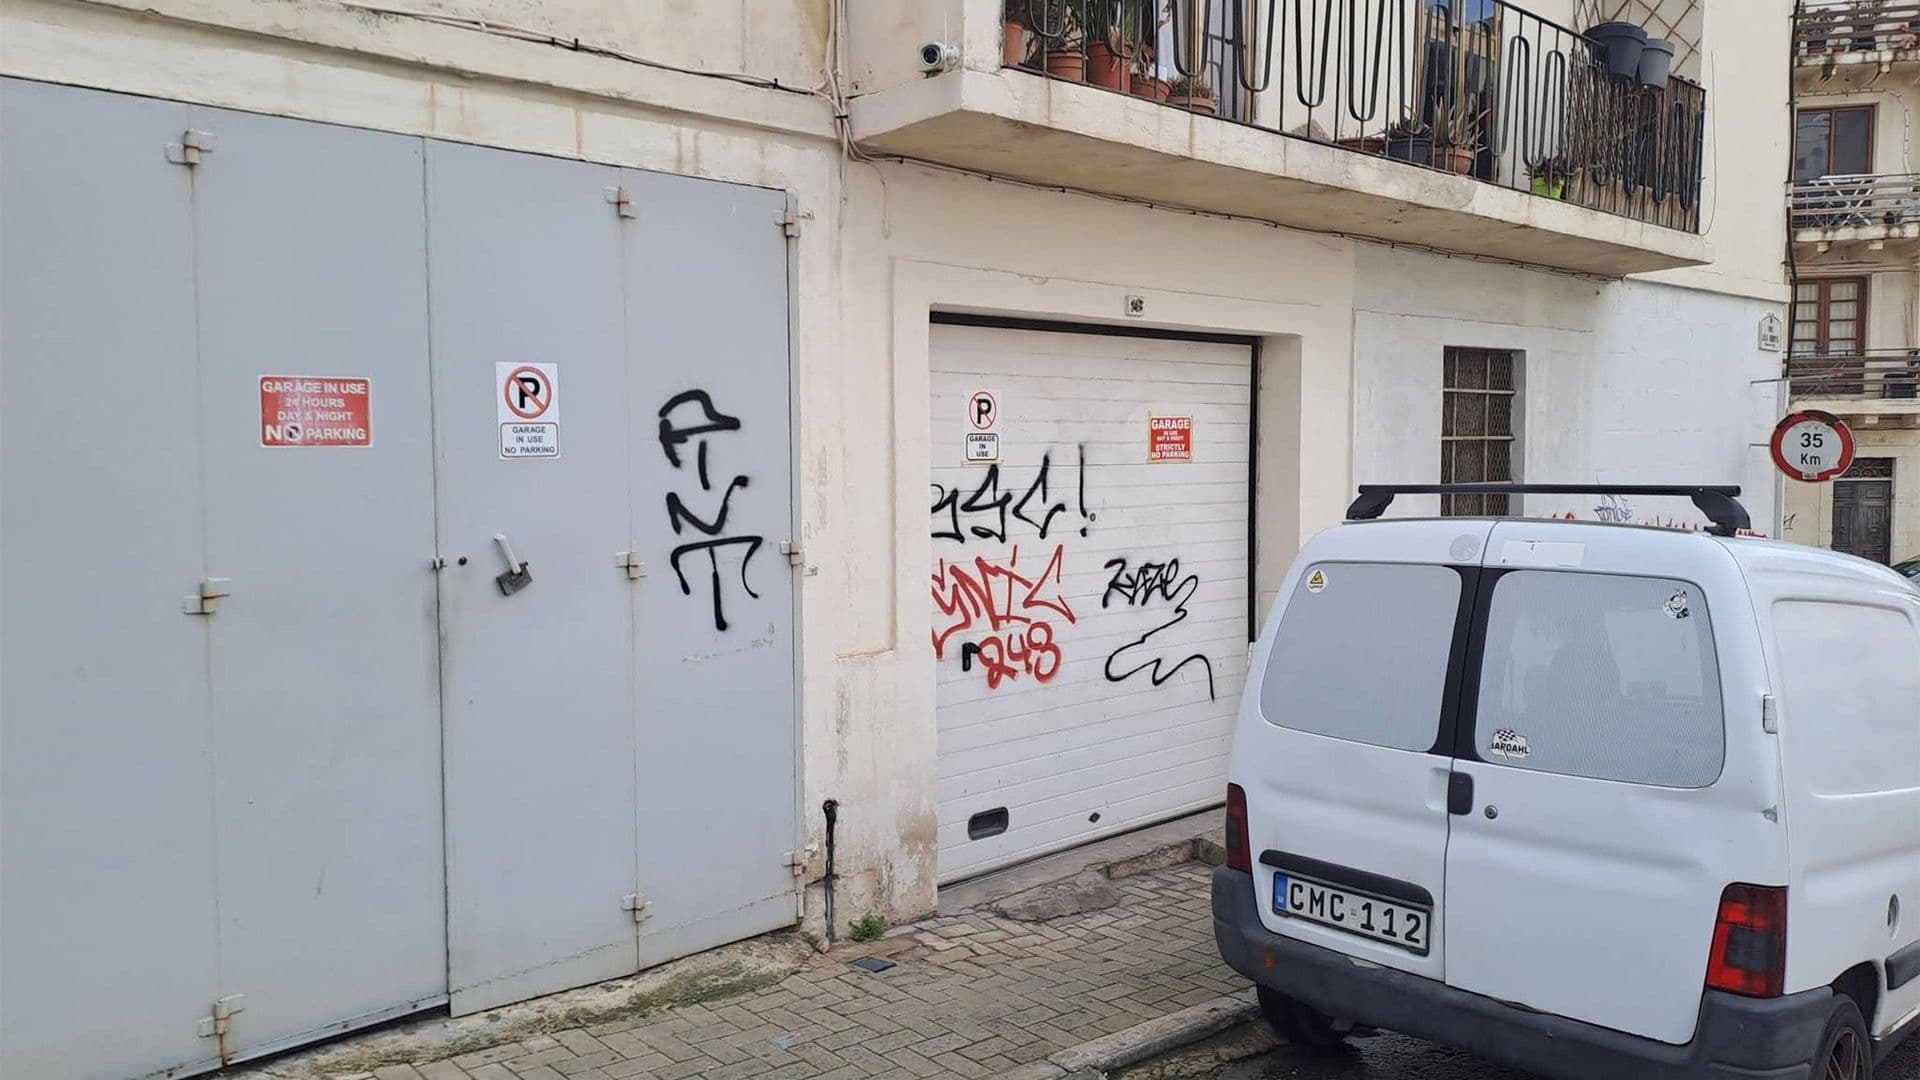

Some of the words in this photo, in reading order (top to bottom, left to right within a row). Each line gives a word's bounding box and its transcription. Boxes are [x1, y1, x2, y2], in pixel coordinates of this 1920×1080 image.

[262, 381, 323, 393] GARAGE
[324, 382, 337, 393] IN
[340, 383, 366, 394] USE
[284, 398, 299, 408] 24
[302, 397, 345, 408] HOURS
[277, 411, 300, 421] DAY
[315, 411, 353, 421] NIGHT
[512, 426, 546, 434] GARAGE
[1151, 419, 1190, 430] GARAGE
[306, 427, 366, 440] PARKING
[527, 435, 543, 443] USE
[1800, 432, 1823, 448] 35
[520, 446, 555, 454] PARKING
[1155, 443, 1186, 451] STRICTLY
[1151, 451, 1161, 459] NO
[1162, 450, 1190, 459] PARKING
[1800, 453, 1821, 465] Km
[1290, 883, 1345, 921] CMC
[1360, 902, 1421, 944] 112
